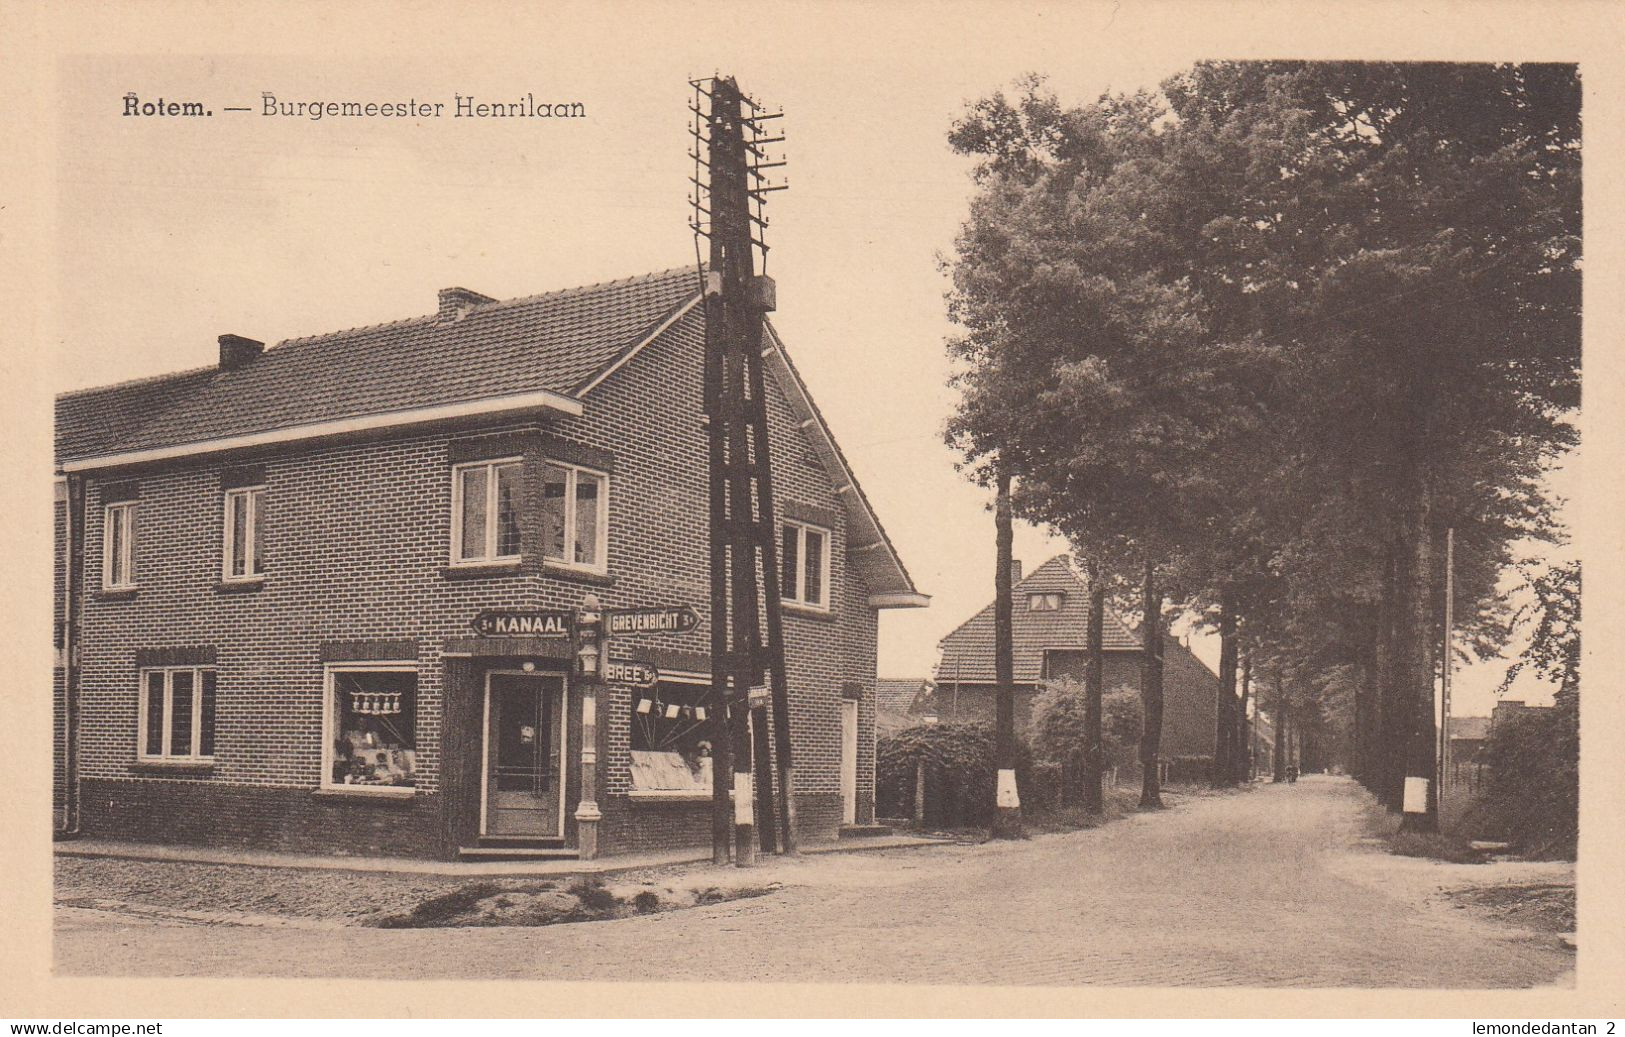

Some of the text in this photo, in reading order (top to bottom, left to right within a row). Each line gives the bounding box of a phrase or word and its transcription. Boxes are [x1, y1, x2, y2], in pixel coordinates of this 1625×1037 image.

[495, 616, 568, 633] KANAAL
[612, 612, 679, 630] GREVENBICHT
[607, 664, 642, 681] BREE
